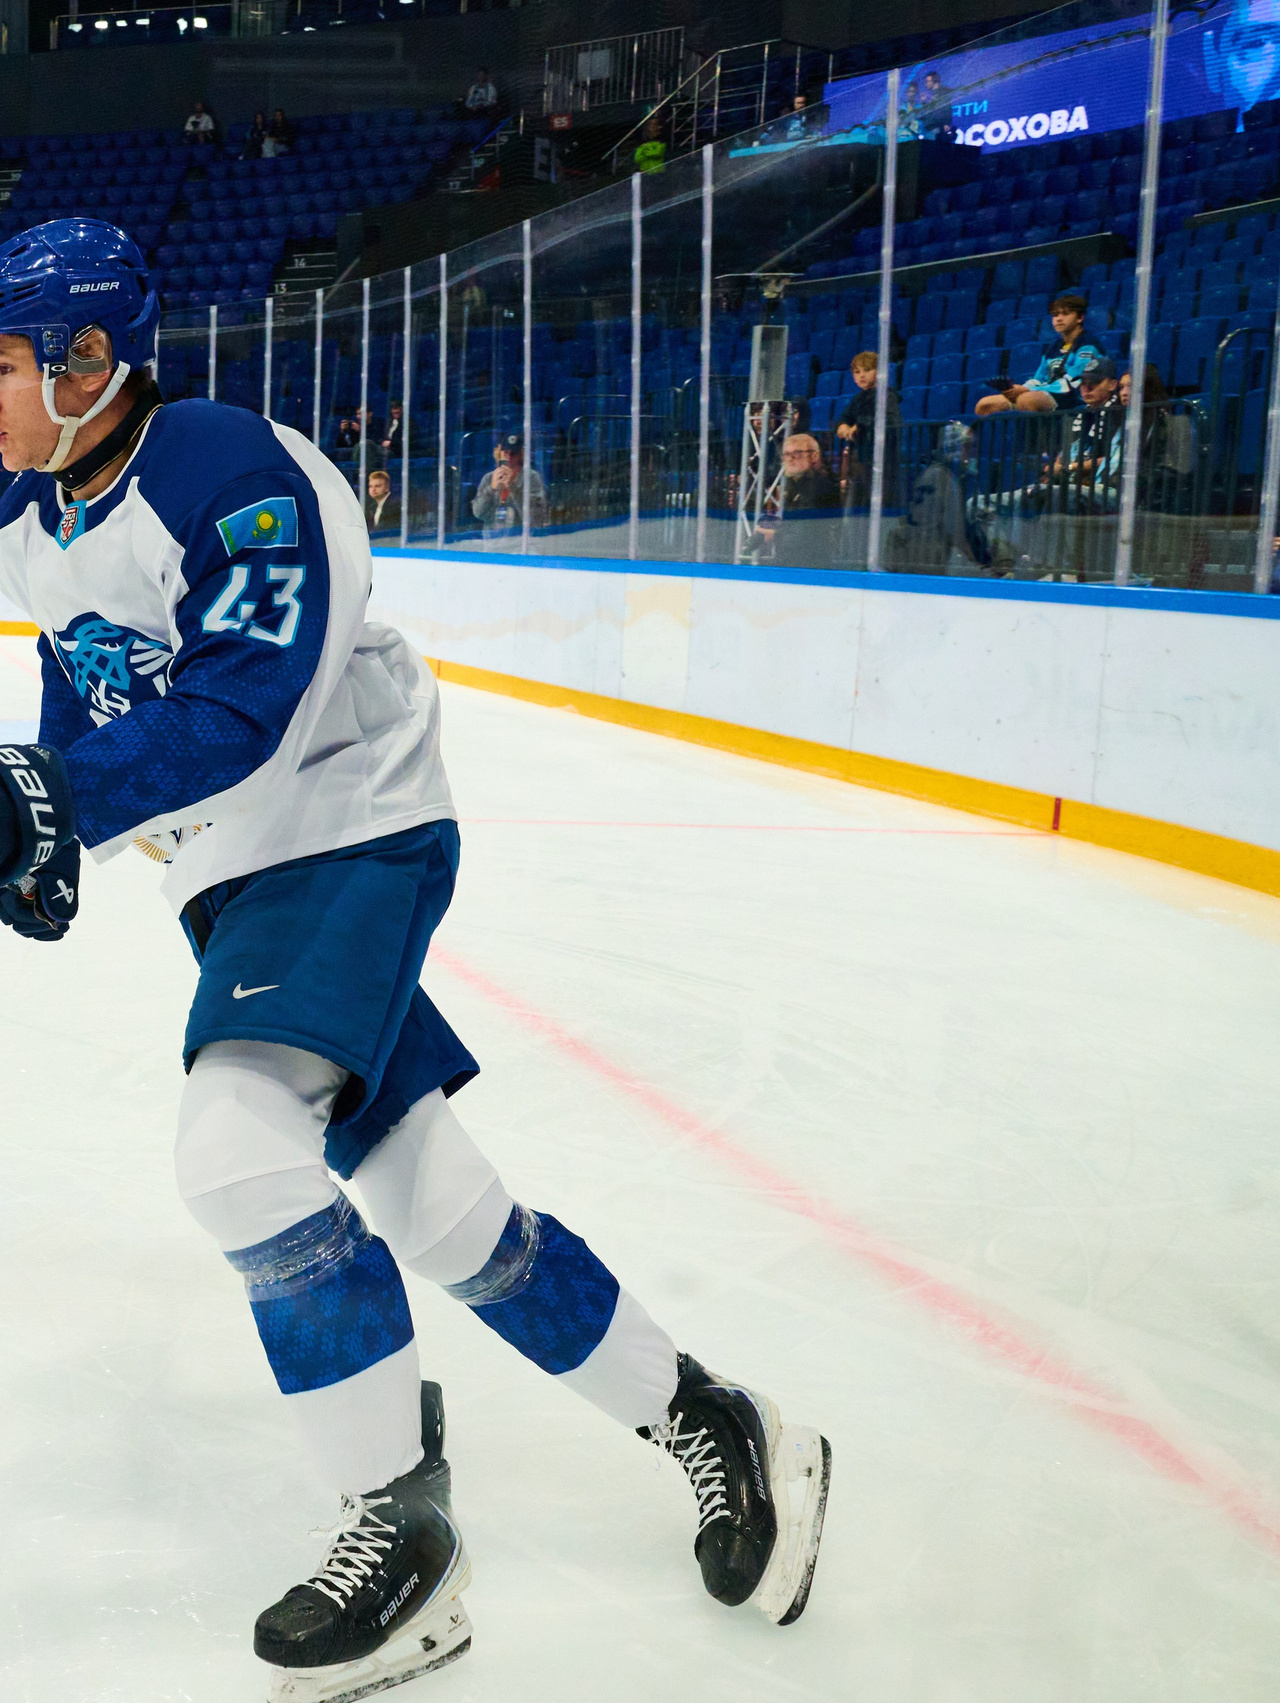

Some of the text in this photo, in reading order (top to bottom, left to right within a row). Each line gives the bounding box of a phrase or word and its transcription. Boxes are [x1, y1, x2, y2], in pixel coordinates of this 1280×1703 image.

[70, 281, 120, 294] BAUER
[202, 564, 306, 648] 43
[746, 1438, 767, 1501] BAUER
[379, 1572, 420, 1628] BAUER
